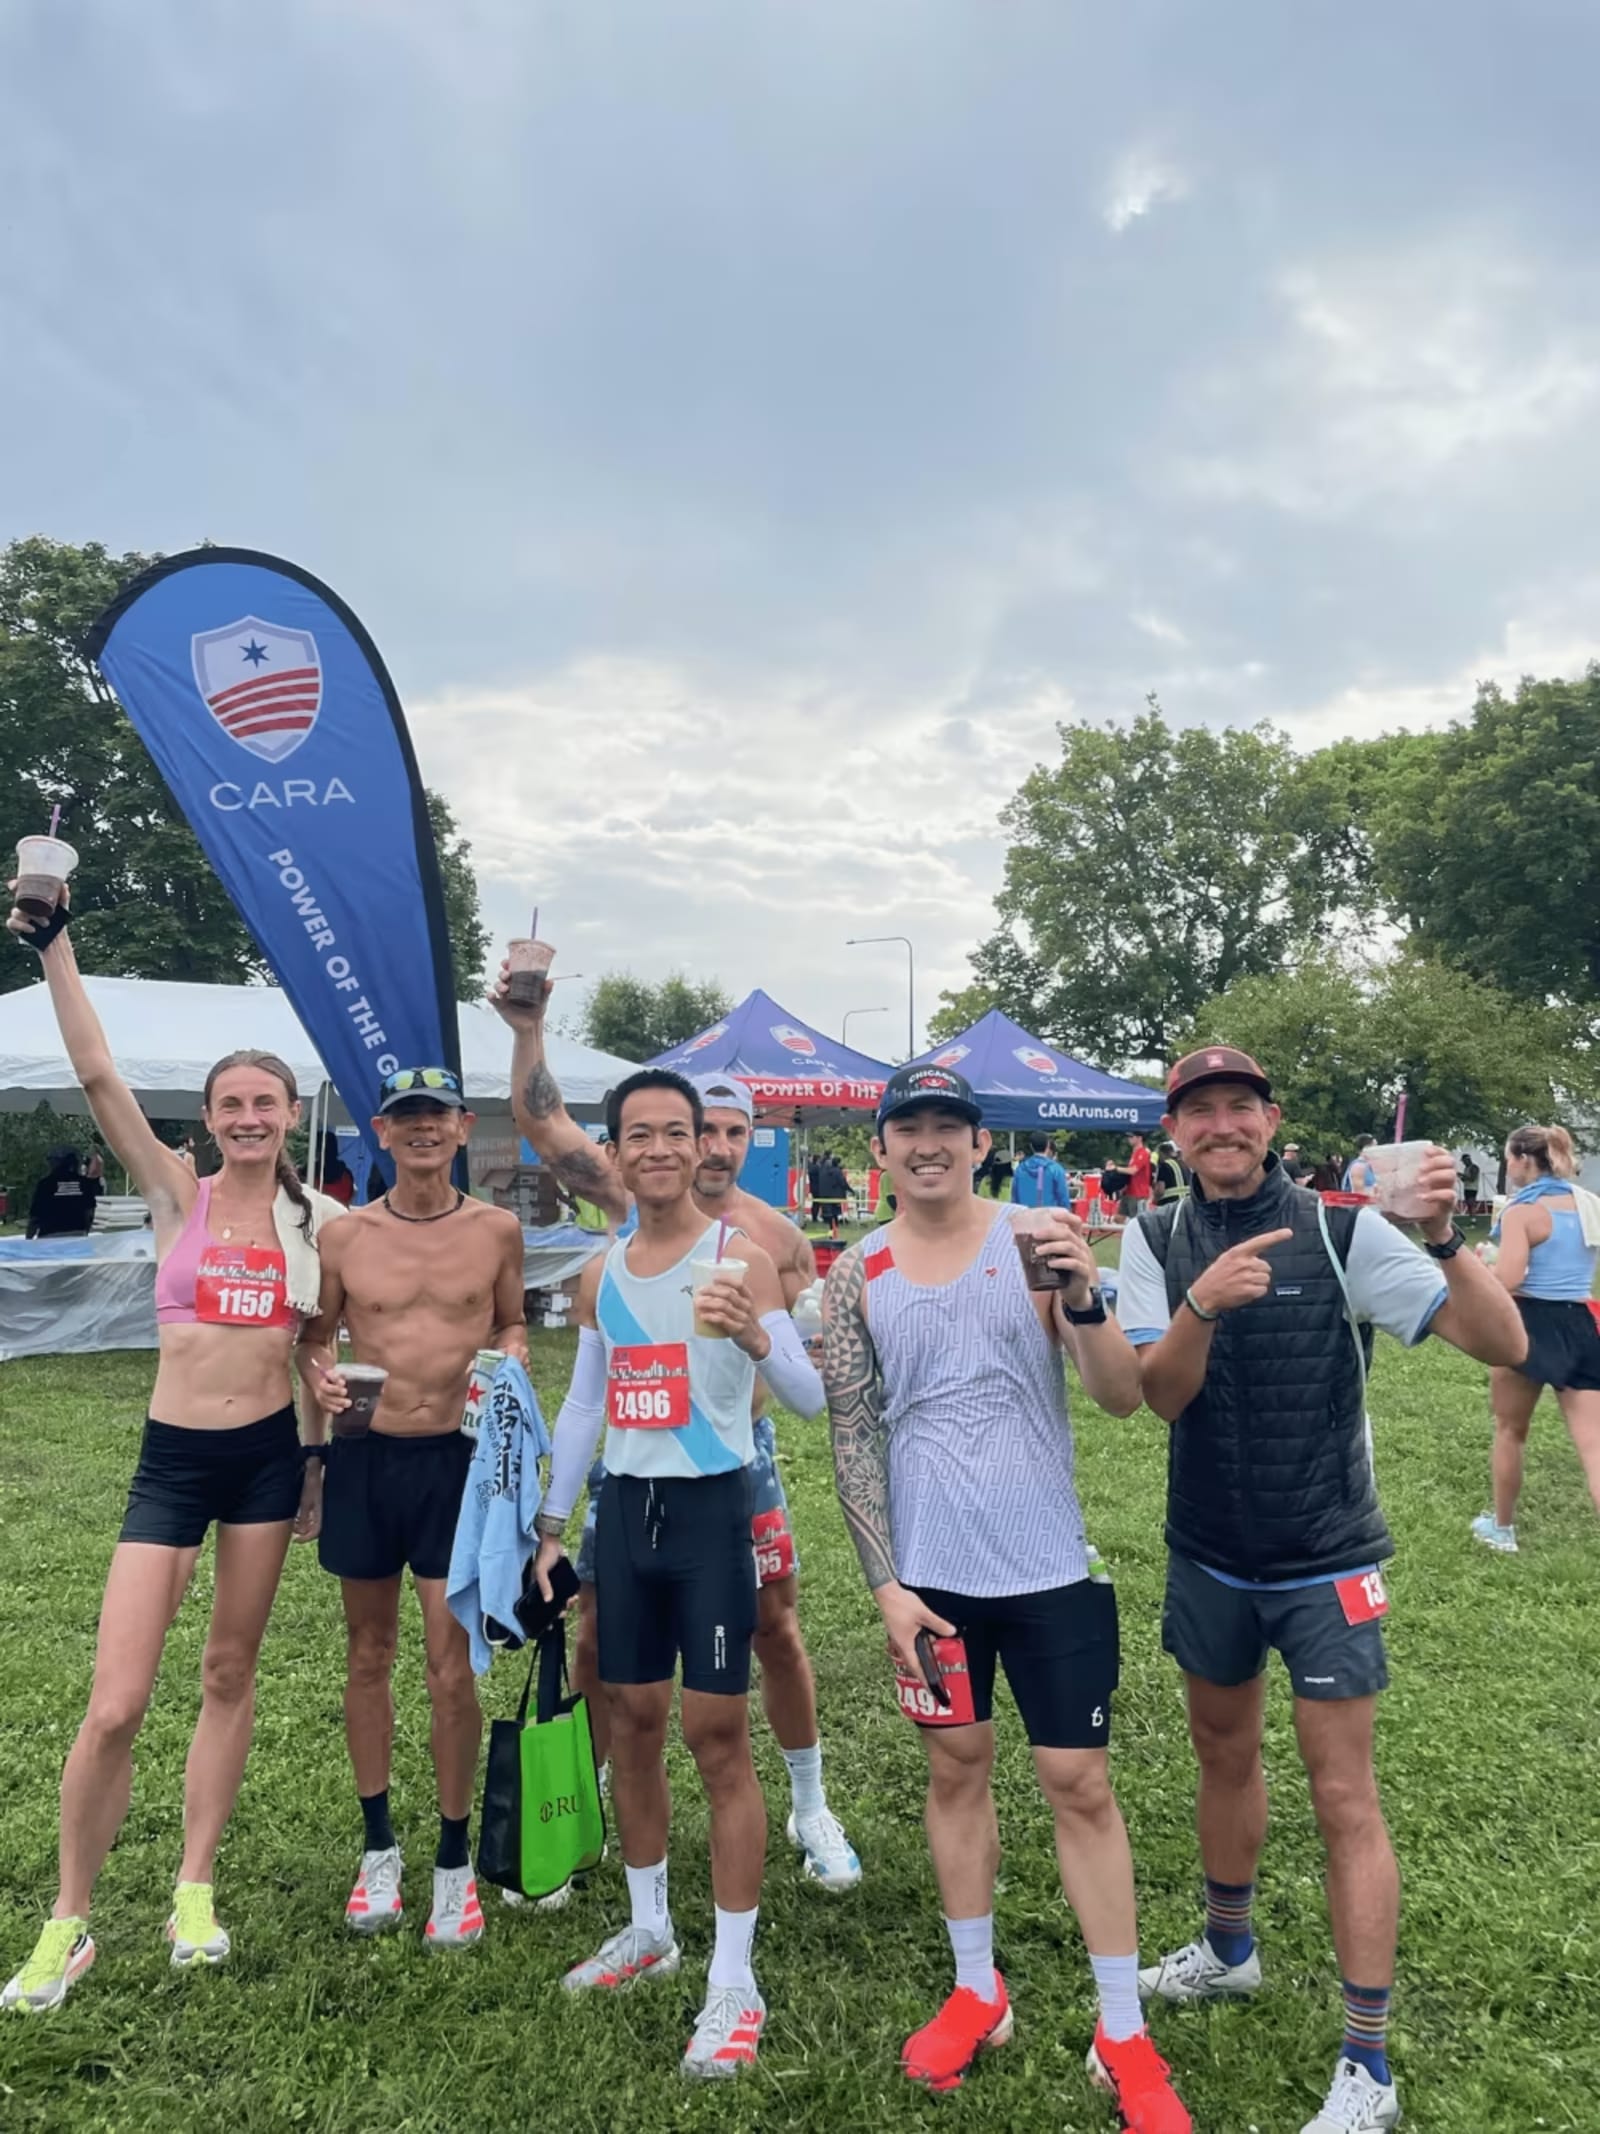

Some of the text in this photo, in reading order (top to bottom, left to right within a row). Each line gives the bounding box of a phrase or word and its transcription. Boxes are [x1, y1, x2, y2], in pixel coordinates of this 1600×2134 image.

[209, 777, 355, 811] CARA
[268, 848, 335, 952] POWER
[325, 956, 359, 992] OF
[347, 996, 386, 1050] THE
[750, 1082, 879, 1099] POWER OF THE
[1038, 1103, 1139, 1123] CARAruns.org
[217, 1287, 275, 1318] 1158
[615, 1389, 671, 1420] 2496
